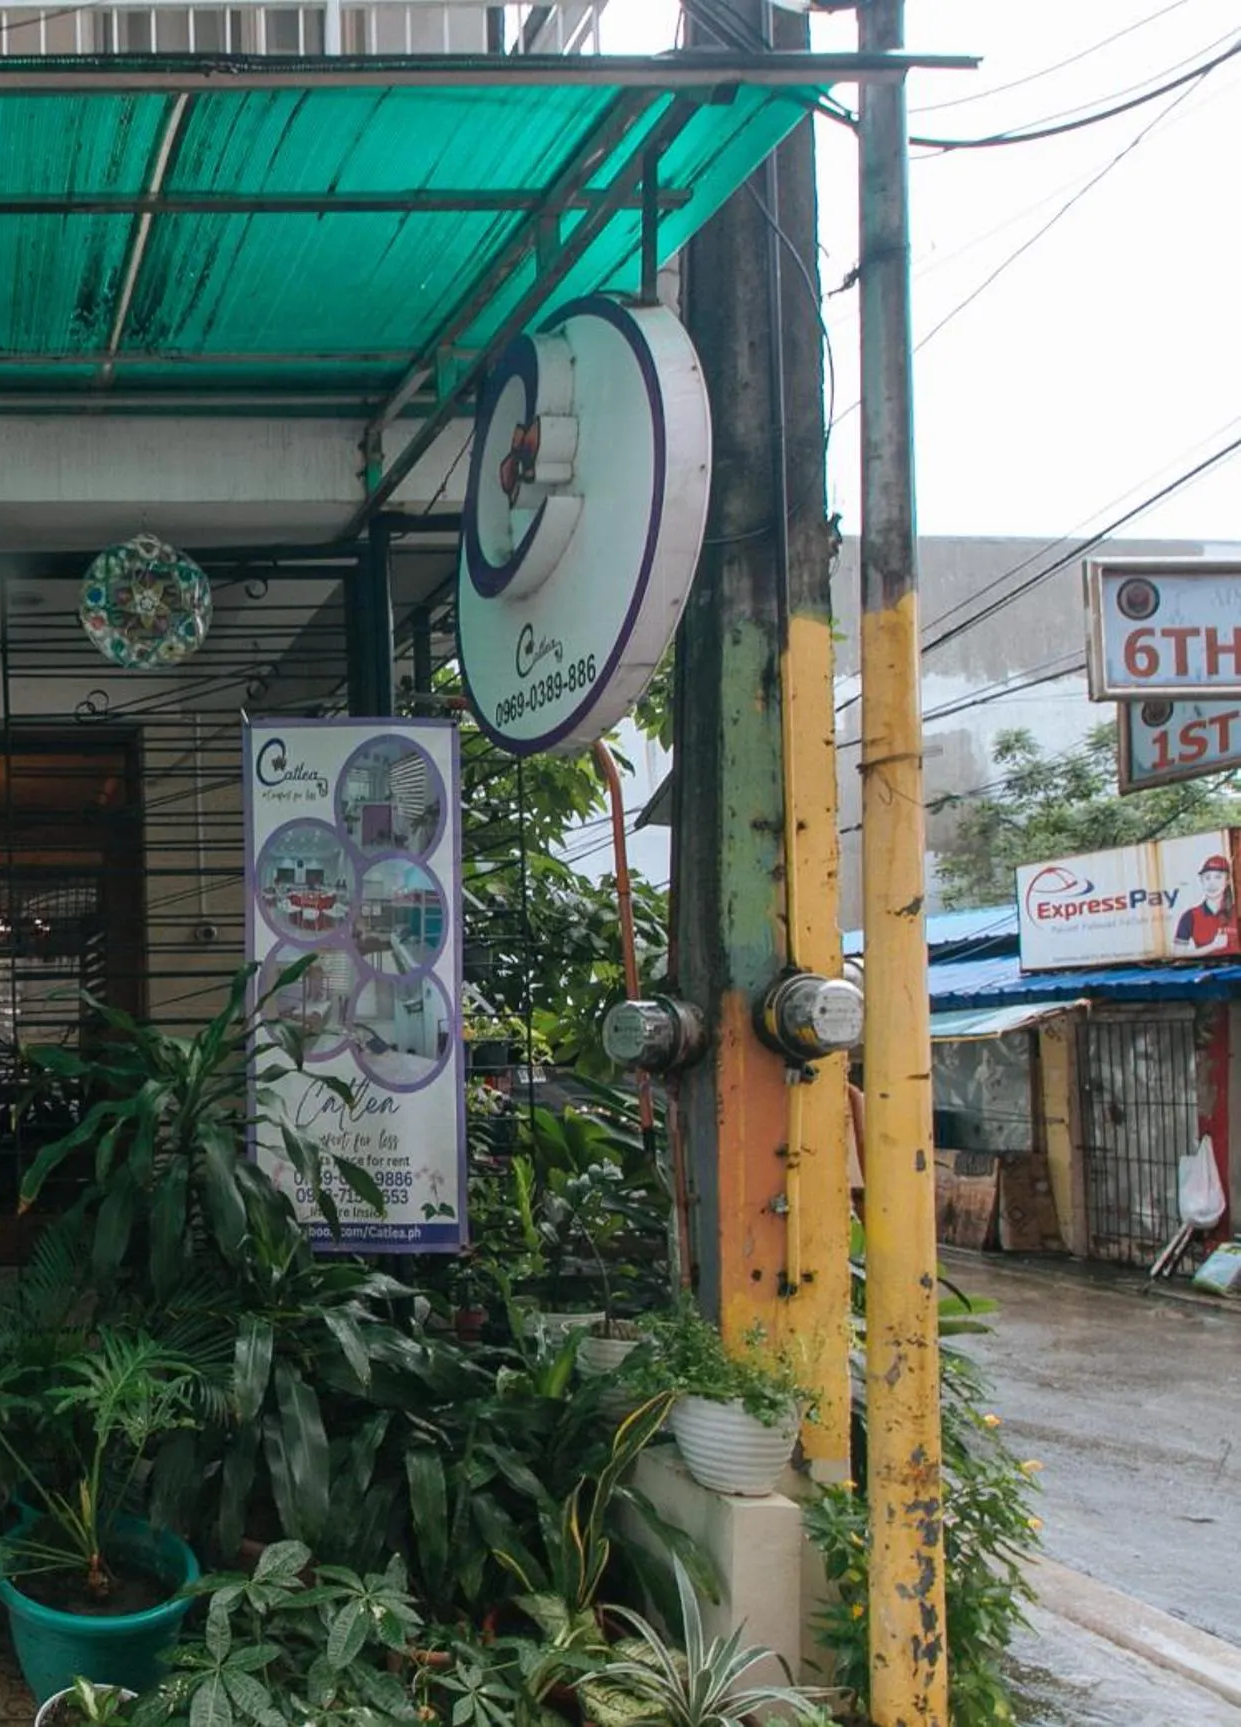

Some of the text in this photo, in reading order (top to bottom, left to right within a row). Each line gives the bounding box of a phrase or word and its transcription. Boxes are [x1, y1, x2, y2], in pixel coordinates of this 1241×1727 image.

[1124, 627, 1241, 678] 6TH
[496, 653, 596, 728] 0969-0389-886
[1151, 710, 1240, 770] 1ST
[1037, 888, 1179, 920] ExpressPay
[366, 1154, 382, 1168] for
[386, 1156, 409, 1168] rent
